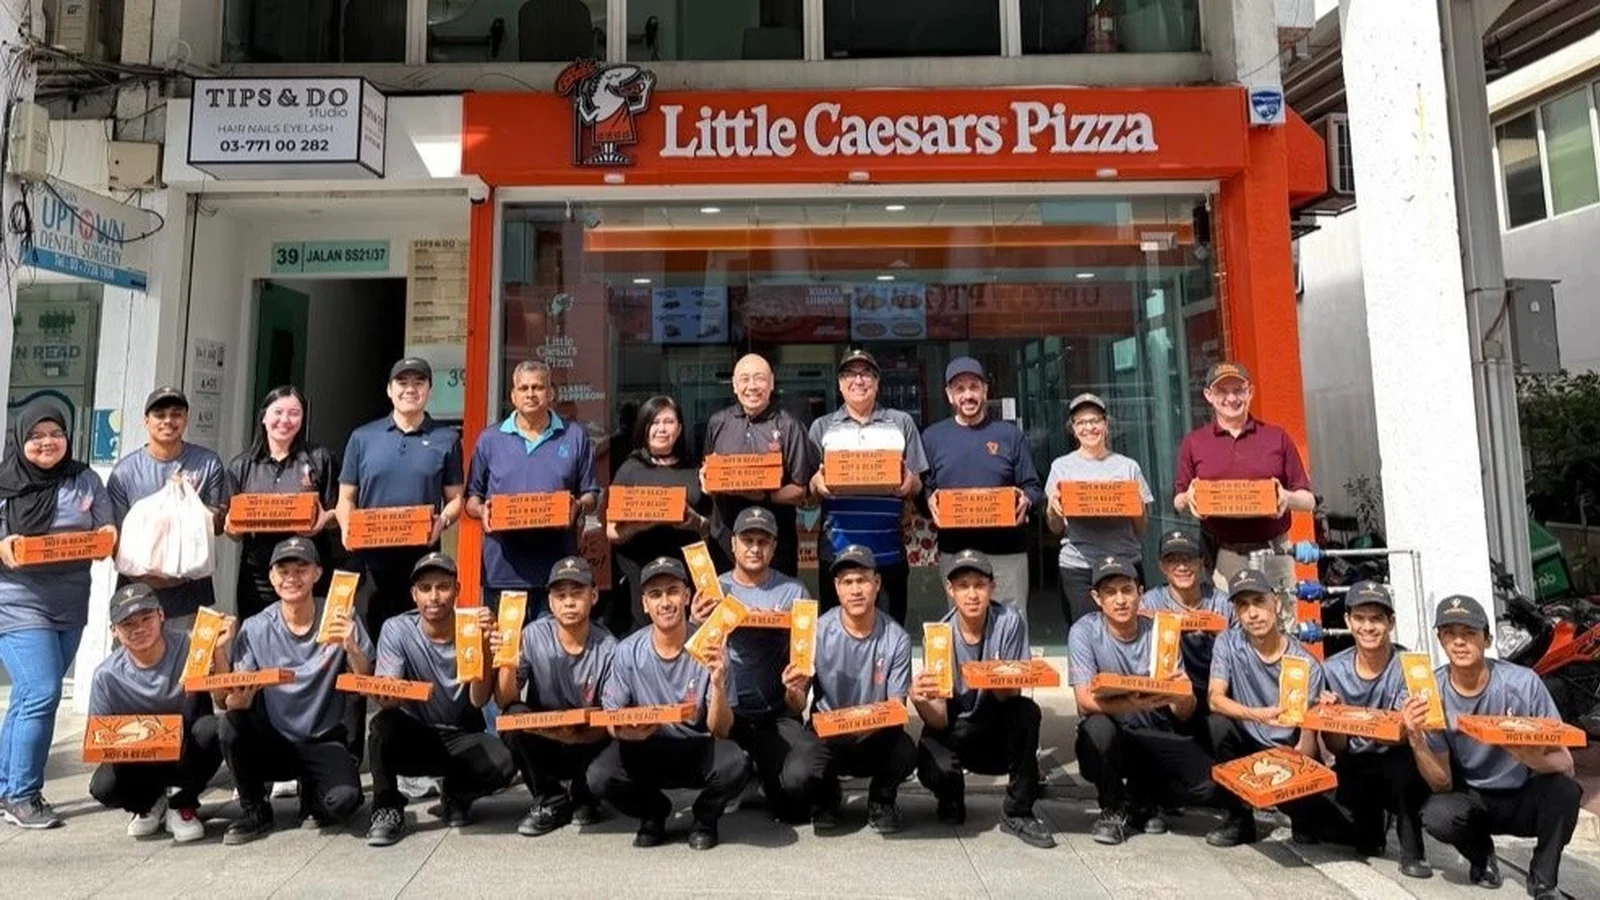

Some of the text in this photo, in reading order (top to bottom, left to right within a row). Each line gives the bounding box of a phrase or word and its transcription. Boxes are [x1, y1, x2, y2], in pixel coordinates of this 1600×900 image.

[206, 88, 348, 108] TIPS & DO
[308, 107, 348, 118] studio
[218, 124, 334, 133] HAIR NAILS EYELASH
[659, 100, 1158, 158] Little Caesars Pizza
[220, 140, 329, 152] 03-771 00 282
[42, 196, 126, 249] UPTOWN
[40, 230, 122, 266] DENTAL SURGERY
[276, 248, 385, 265] 39 JALAN SS21/37
[809, 287, 840, 295] KUALA
[544, 336, 574, 346] Little
[33, 345, 80, 359] READ
[536, 345, 578, 356] Caesars
[544, 357, 574, 369] Pizza
[743, 456, 764, 464] READY
[862, 451, 883, 459] READY
[744, 468, 765, 476] READY
[862, 463, 883, 471] READY
[721, 480, 734, 488] HOT
[742, 479, 763, 487] READY
[1078, 483, 1092, 491] HOT
[626, 488, 639, 496] HOT
[1234, 493, 1257, 501] READY
[272, 498, 294, 506] READY
[510, 495, 524, 504] HOT
[531, 494, 552, 502] READY
[976, 494, 997, 502] READY
[626, 500, 639, 508] HOT
[646, 500, 668, 508] READY
[269, 510, 292, 518] READY
[509, 507, 522, 515] HOT
[530, 506, 552, 514] READY
[389, 512, 412, 520] READY
[508, 518, 522, 526] HOT
[529, 517, 552, 526] READY
[367, 525, 381, 533] HOT
[389, 524, 412, 532] READY
[364, 537, 378, 545] HOT
[386, 536, 408, 544] READY
[205, 677, 221, 686] HOT
[231, 674, 256, 684] READY
[990, 677, 1006, 685] HOT
[1120, 678, 1136, 687] HOT
[1145, 680, 1170, 690] READY
[356, 681, 372, 690] HOT
[382, 684, 408, 694] READY
[515, 716, 530, 725] HOT
[539, 713, 564, 723] READY
[610, 714, 625, 722] HOT
[634, 712, 659, 721] READY
[838, 720, 853, 730] HOT
[862, 715, 888, 727] READY
[1324, 720, 1340, 730] HOT
[1349, 723, 1376, 734] READY
[1506, 732, 1523, 742] HOT
[1534, 733, 1562, 742] READY
[104, 751, 121, 760] HOT
[130, 750, 158, 759] READY
[1275, 789, 1289, 800] HOT
[1297, 782, 1320, 795] READY
